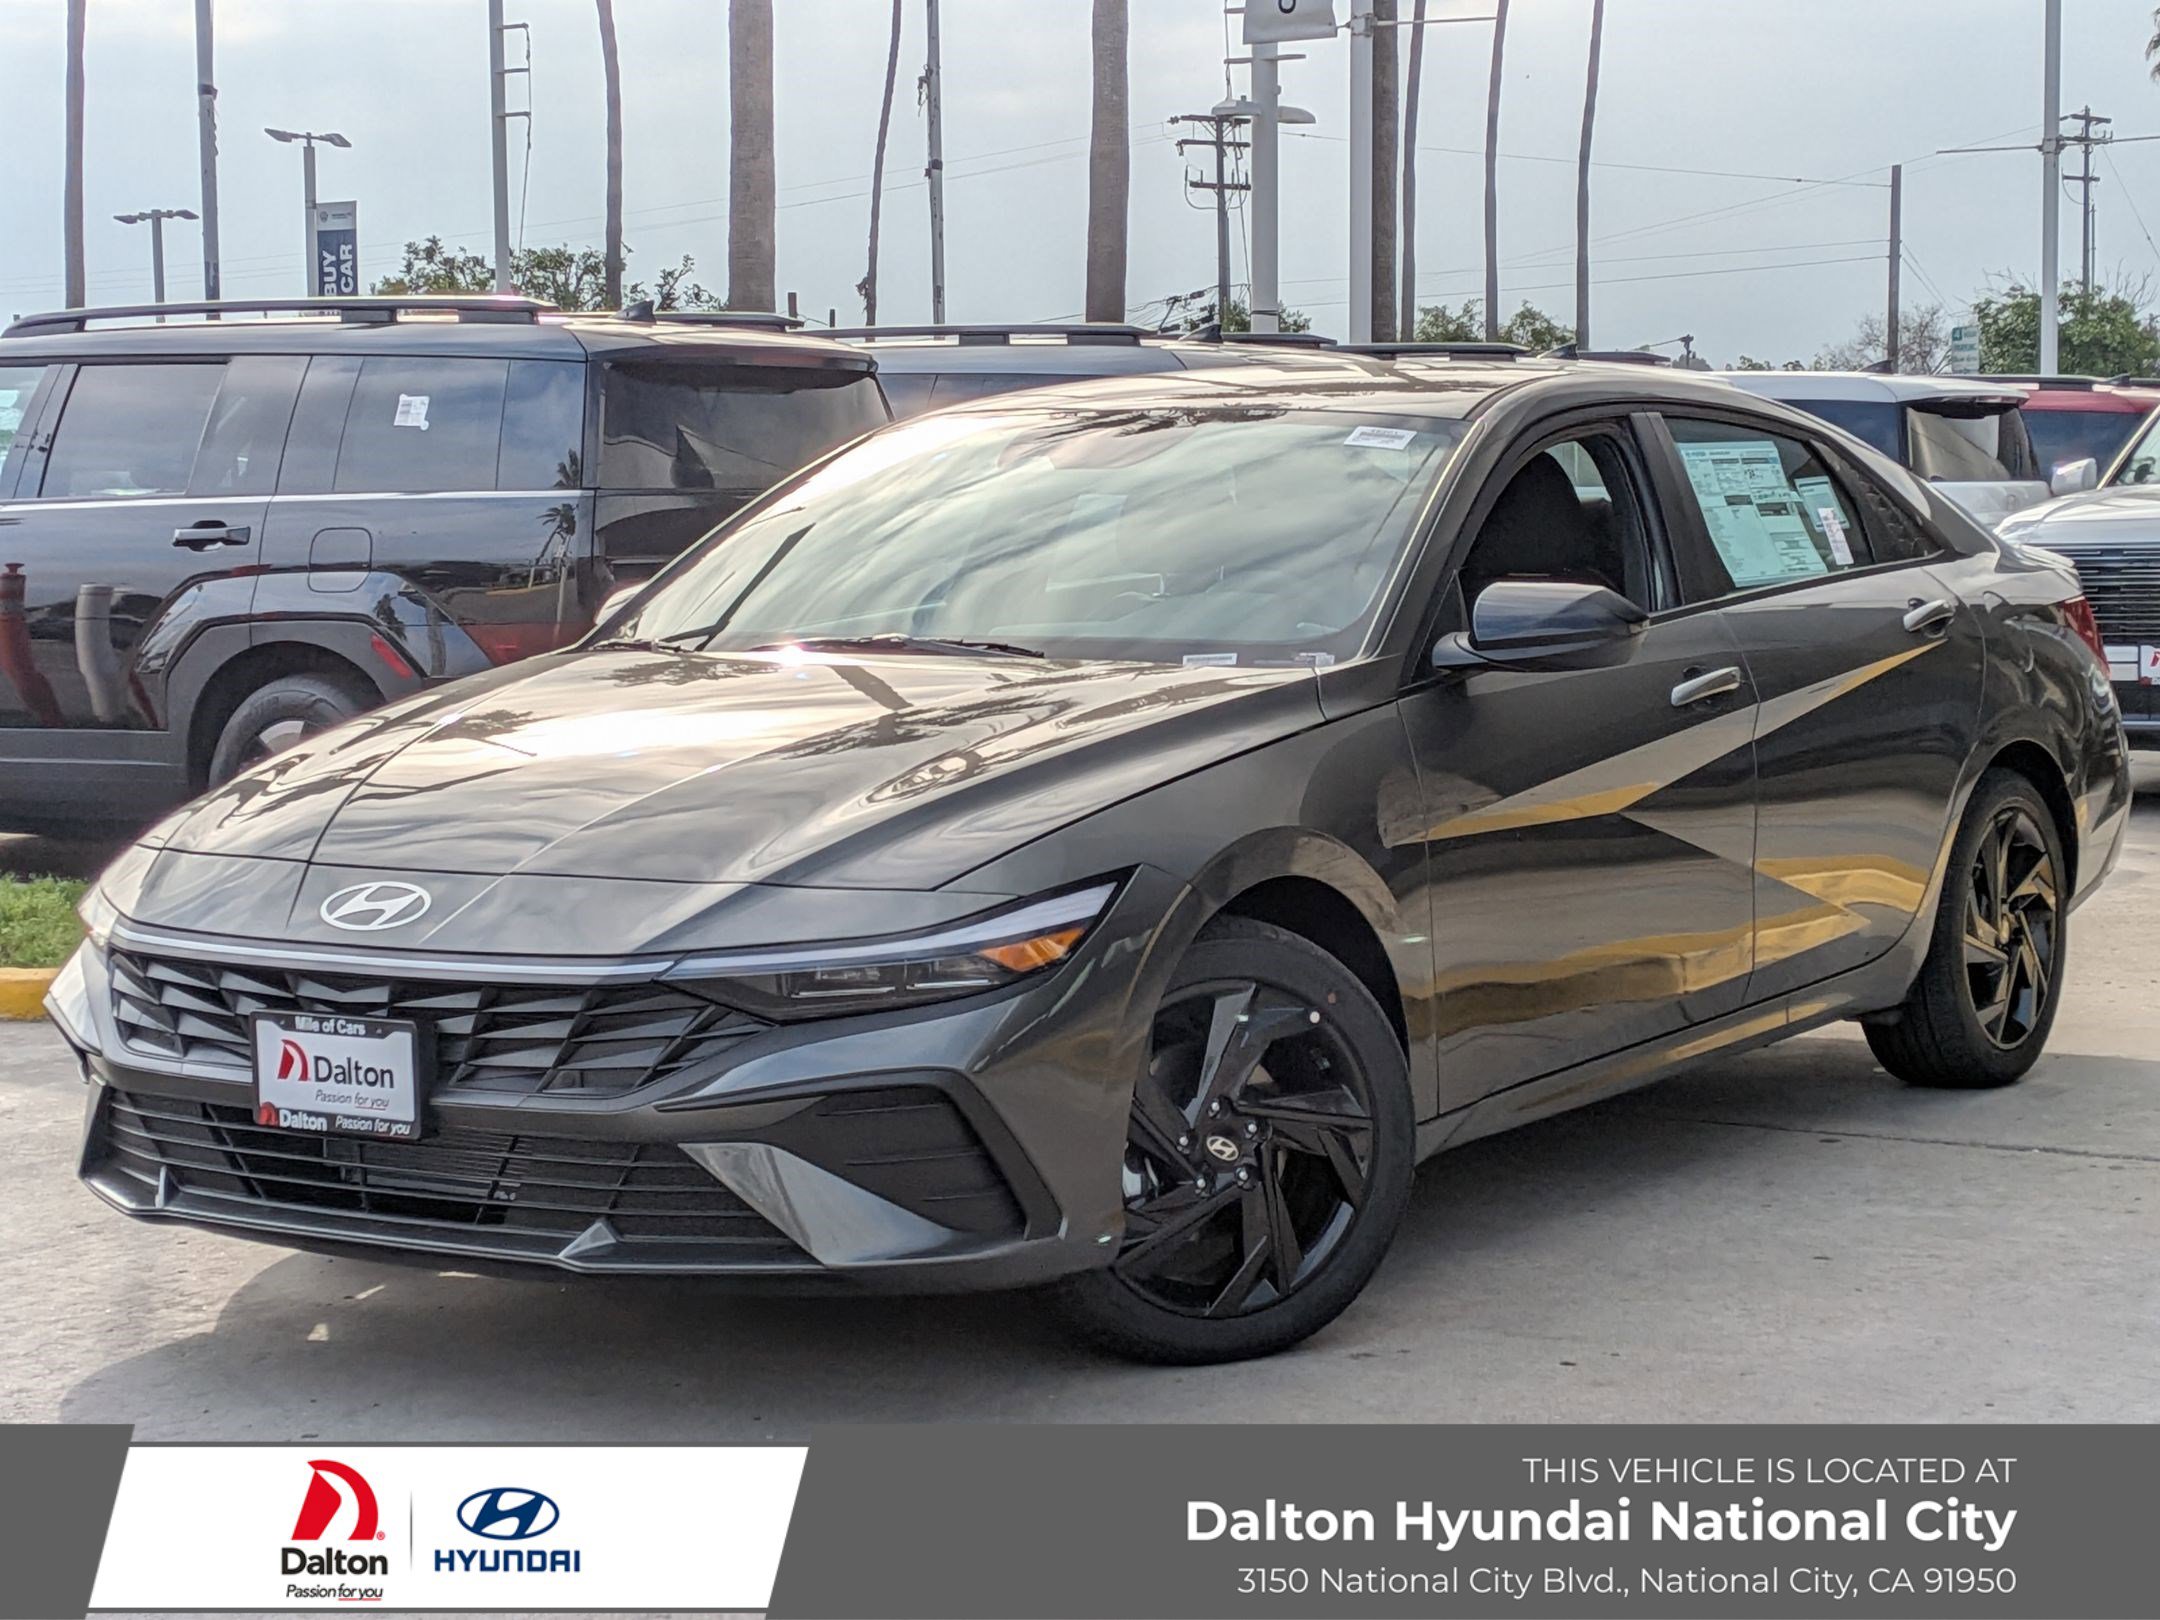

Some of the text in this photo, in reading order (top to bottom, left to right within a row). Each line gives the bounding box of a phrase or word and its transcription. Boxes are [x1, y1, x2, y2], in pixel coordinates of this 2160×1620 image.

[322, 250, 337, 296] BUY
[339, 244, 354, 293] CAR
[295, 1016, 366, 1035] Mile of Cars
[313, 1055, 395, 1089] Dalton
[315, 1089, 390, 1108] Passion for you
[279, 1109, 411, 1136] Dalton Passion for you
